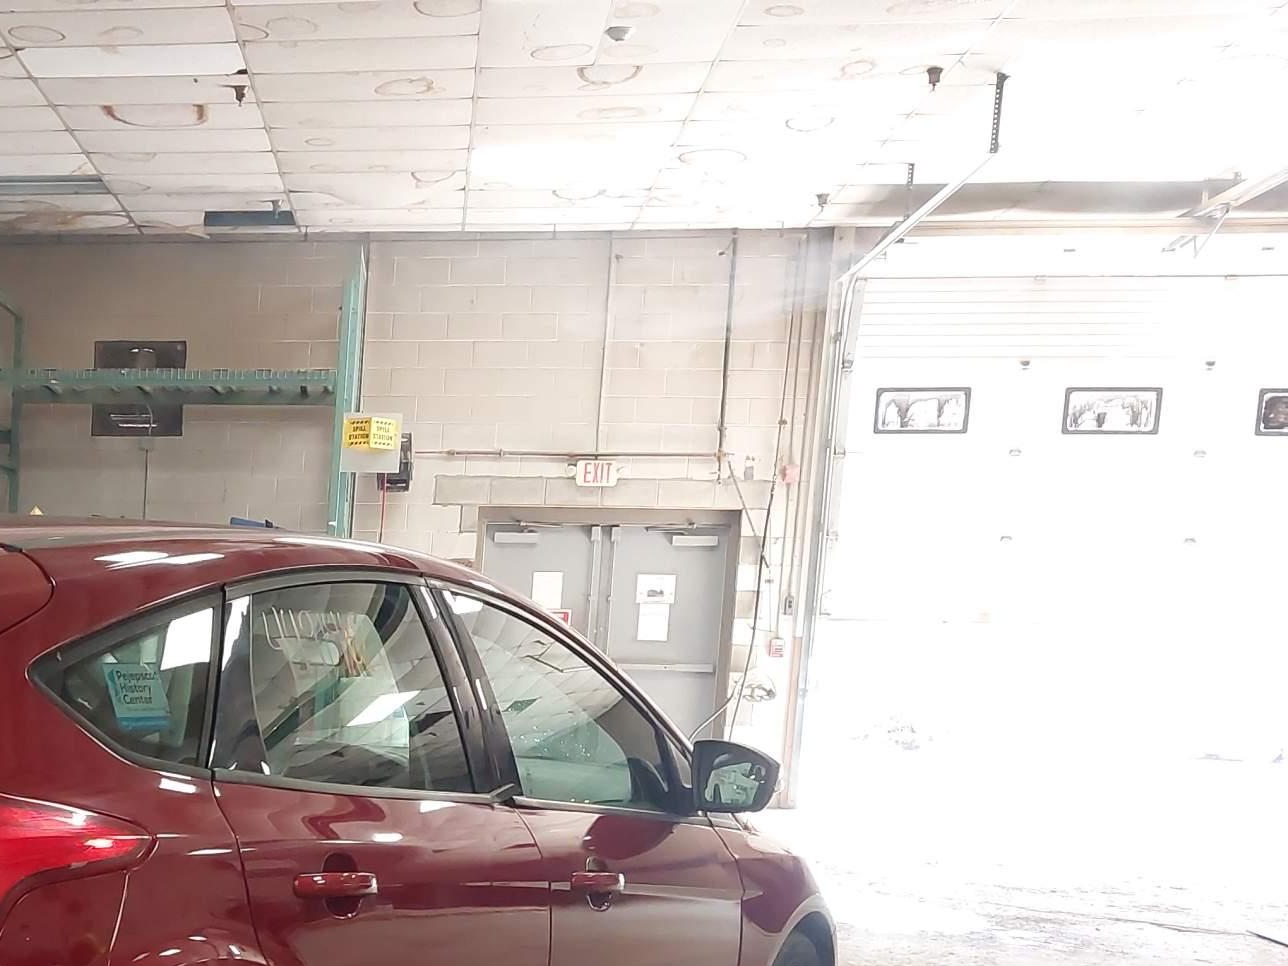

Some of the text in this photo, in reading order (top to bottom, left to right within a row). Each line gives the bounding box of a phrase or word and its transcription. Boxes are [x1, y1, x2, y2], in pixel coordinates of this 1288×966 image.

[583, 462, 613, 483] EXIT
[119, 682, 152, 697] History
[123, 694, 153, 705] Center
